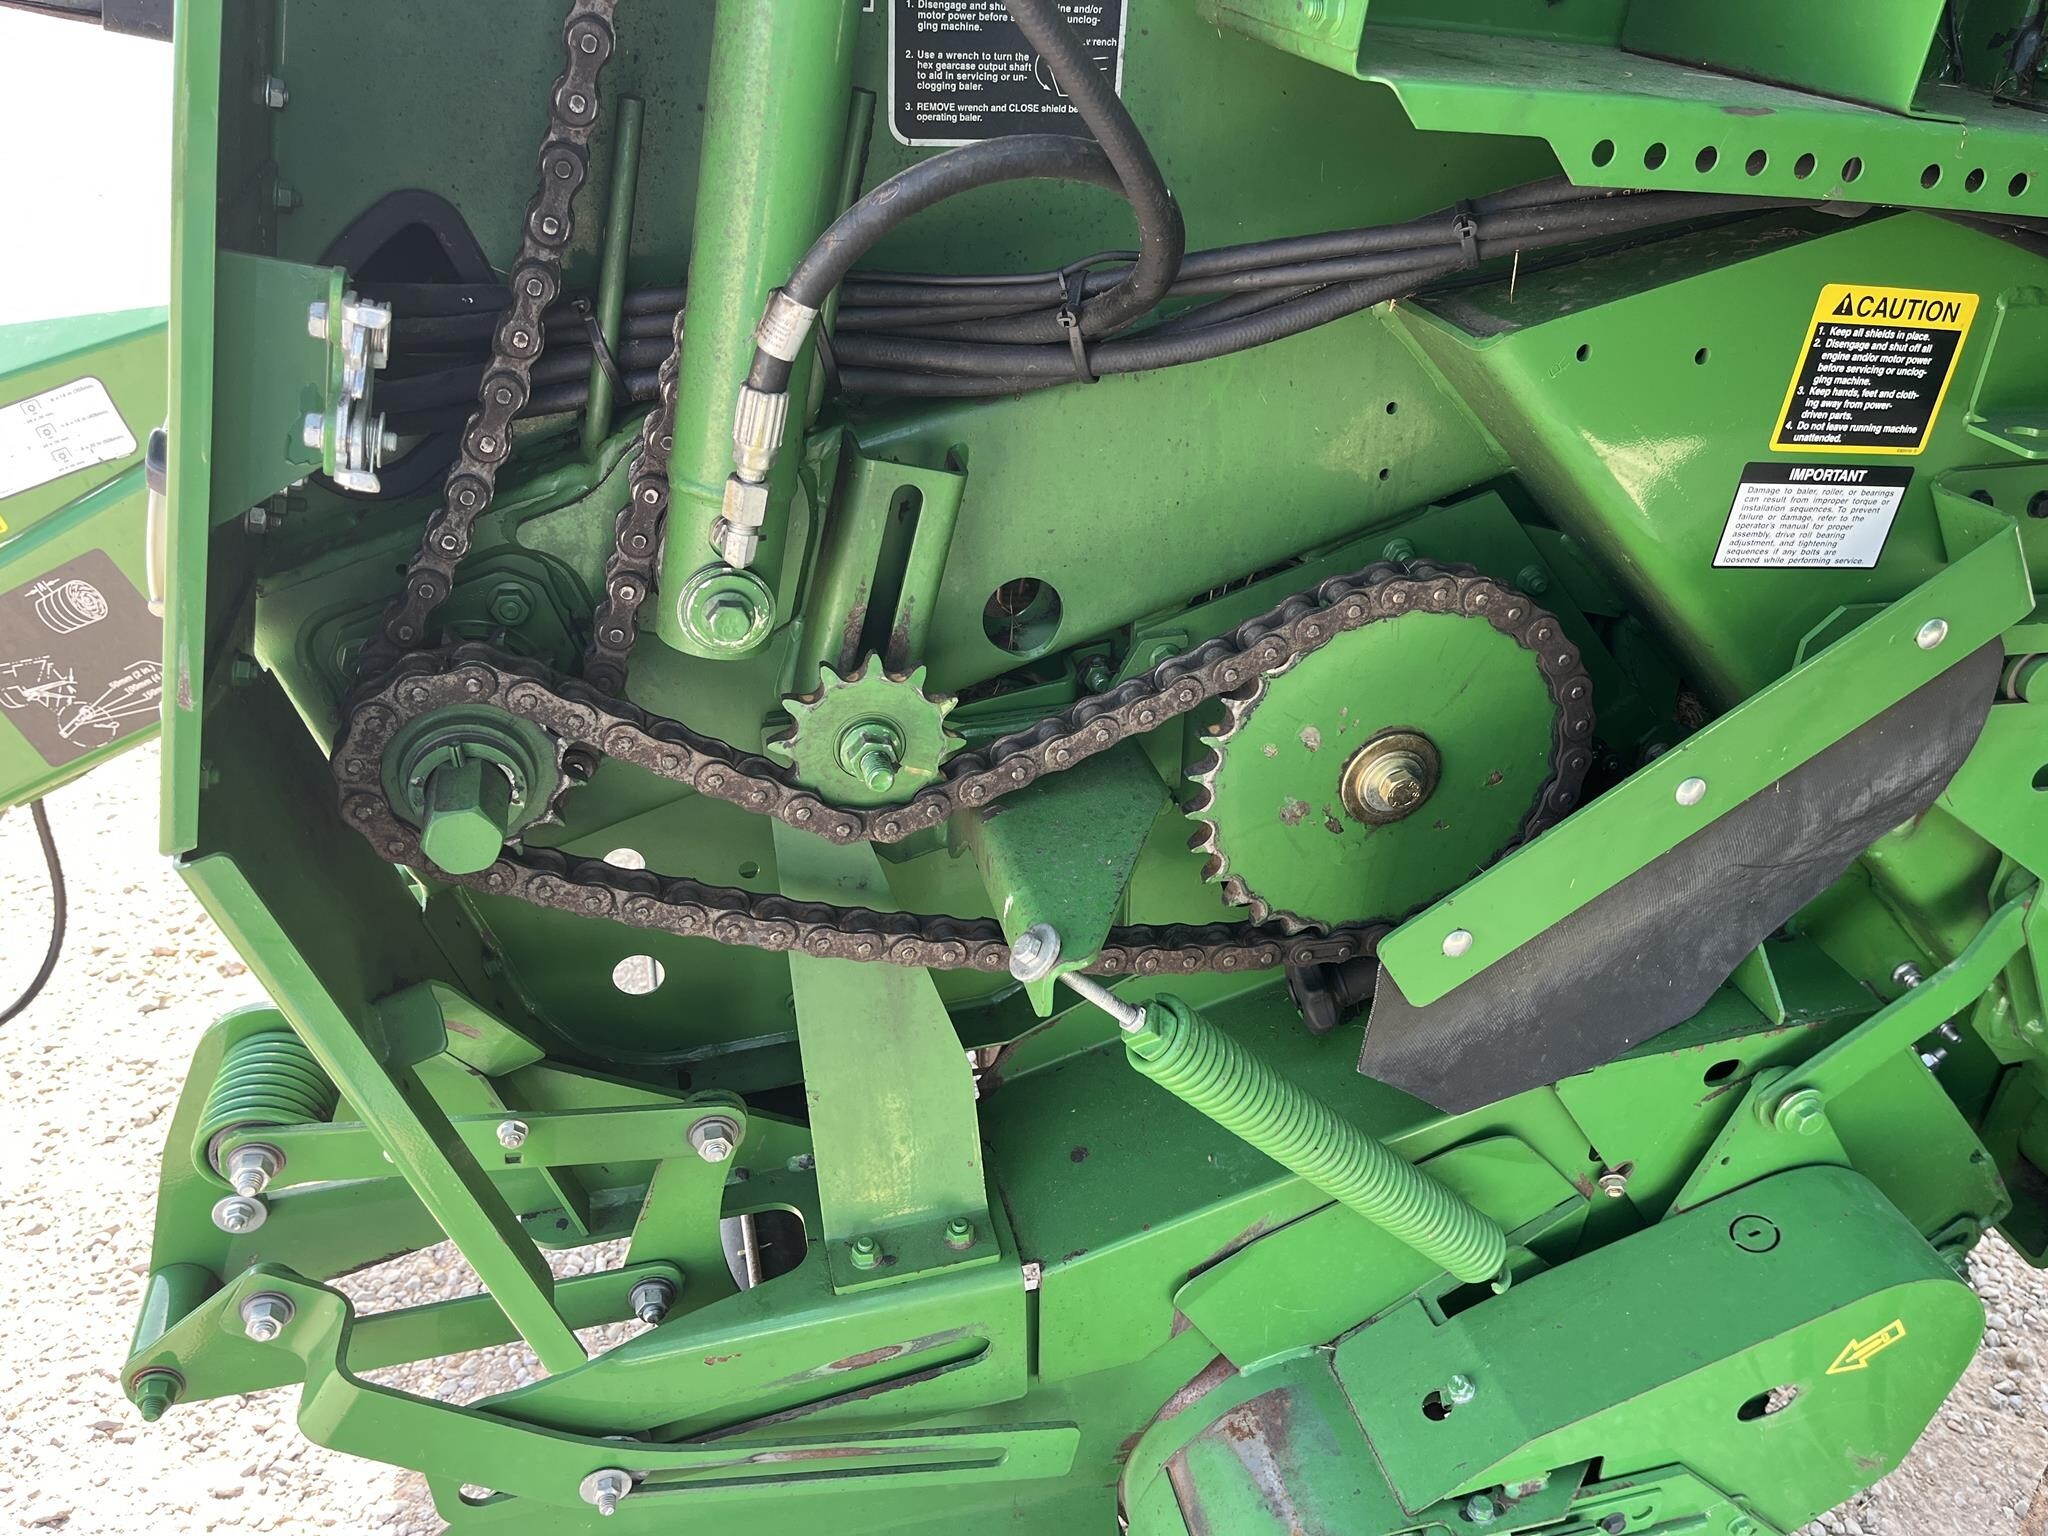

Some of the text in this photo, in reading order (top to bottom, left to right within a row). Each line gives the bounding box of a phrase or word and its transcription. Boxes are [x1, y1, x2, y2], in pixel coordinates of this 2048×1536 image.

[906, 0, 1008, 11] 1. Disengage and shu
[1074, 5, 1103, 13] and/or
[948, 12, 976, 23] power
[979, 12, 1008, 21] before
[1067, 15, 1100, 26] unclog-
[918, 22, 982, 32] ging machine.
[905, 50, 913, 59] 2.
[917, 50, 935, 59] Use
[946, 51, 979, 60] wrench
[982, 52, 991, 60] to
[994, 52, 1012, 60] turn
[1015, 52, 1029, 61] the
[917, 61, 1032, 72] hex gearcase output shaft
[917, 71, 926, 80] to
[929, 71, 942, 80] aid
[945, 71, 954, 80] in
[956, 72, 998, 82] servicing
[1001, 73, 1010, 81] or
[917, 82, 983, 92] clogging baler.
[905, 102, 913, 110] 3.
[917, 103, 955, 111] REMOVE
[958, 104, 988, 112] wrench
[990, 104, 1006, 112] and
[1009, 104, 1039, 112] CLOSE
[1041, 105, 1066, 113] shield
[917, 113, 982, 123] operating baler.
[1856, 295, 1961, 323] CAUTION
[1819, 326, 1930, 341] 1. Keep all shields in place.
[1813, 338, 1933, 353] 2. Disengage and shut off all
[1821, 352, 1932, 366] engine and/or motor power
[1817, 363, 1927, 378] before servicing or unclog-
[1813, 375, 1871, 386] ging machine.
[1797, 386, 1919, 399] 3. Keep hands, feet and cloth-
[1805, 398, 1892, 411] ing away from power-
[1801, 410, 1853, 421] driven parts.
[1785, 421, 1917, 434] 4. Do not leave running machine
[1793, 434, 1841, 442] unattended.
[1788, 468, 1868, 483] IMPORTANT
[1748, 487, 1780, 495] Damage
[1813, 497, 1848, 505] improper
[1780, 514, 1813, 522] damage,
[1732, 531, 1771, 539] assembly,
[1729, 540, 1775, 548] adjustment,
[1798, 540, 1837, 548] tightening
[1788, 557, 1830, 565] performing
